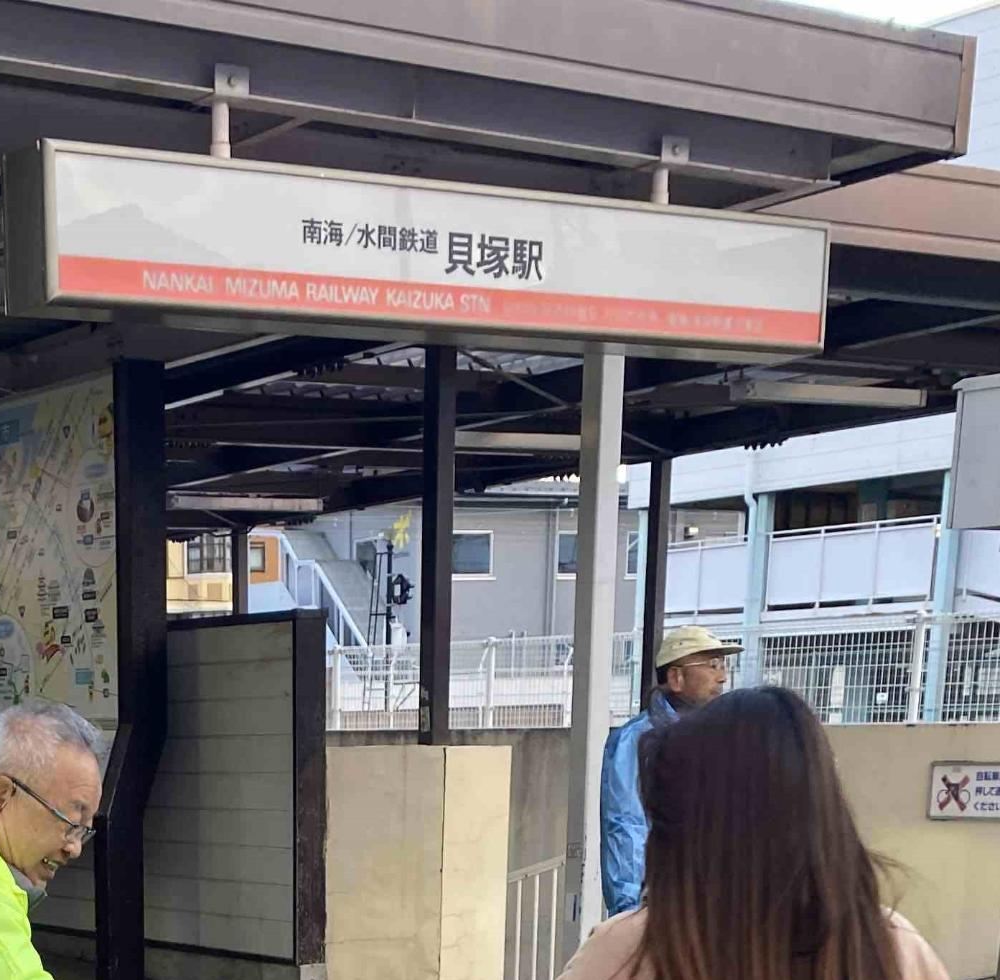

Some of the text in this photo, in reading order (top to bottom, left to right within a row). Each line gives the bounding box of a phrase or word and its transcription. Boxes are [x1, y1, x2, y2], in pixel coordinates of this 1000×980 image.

[301, 217, 543, 281] 南海/水間鉄道 貝塚駅
[142, 270, 215, 295] NANKAI
[225, 277, 299, 301] MIZUMA
[305, 281, 379, 305] RAILWAY
[386, 287, 454, 311] KAIZUKA
[460, 294, 491, 313] STN
